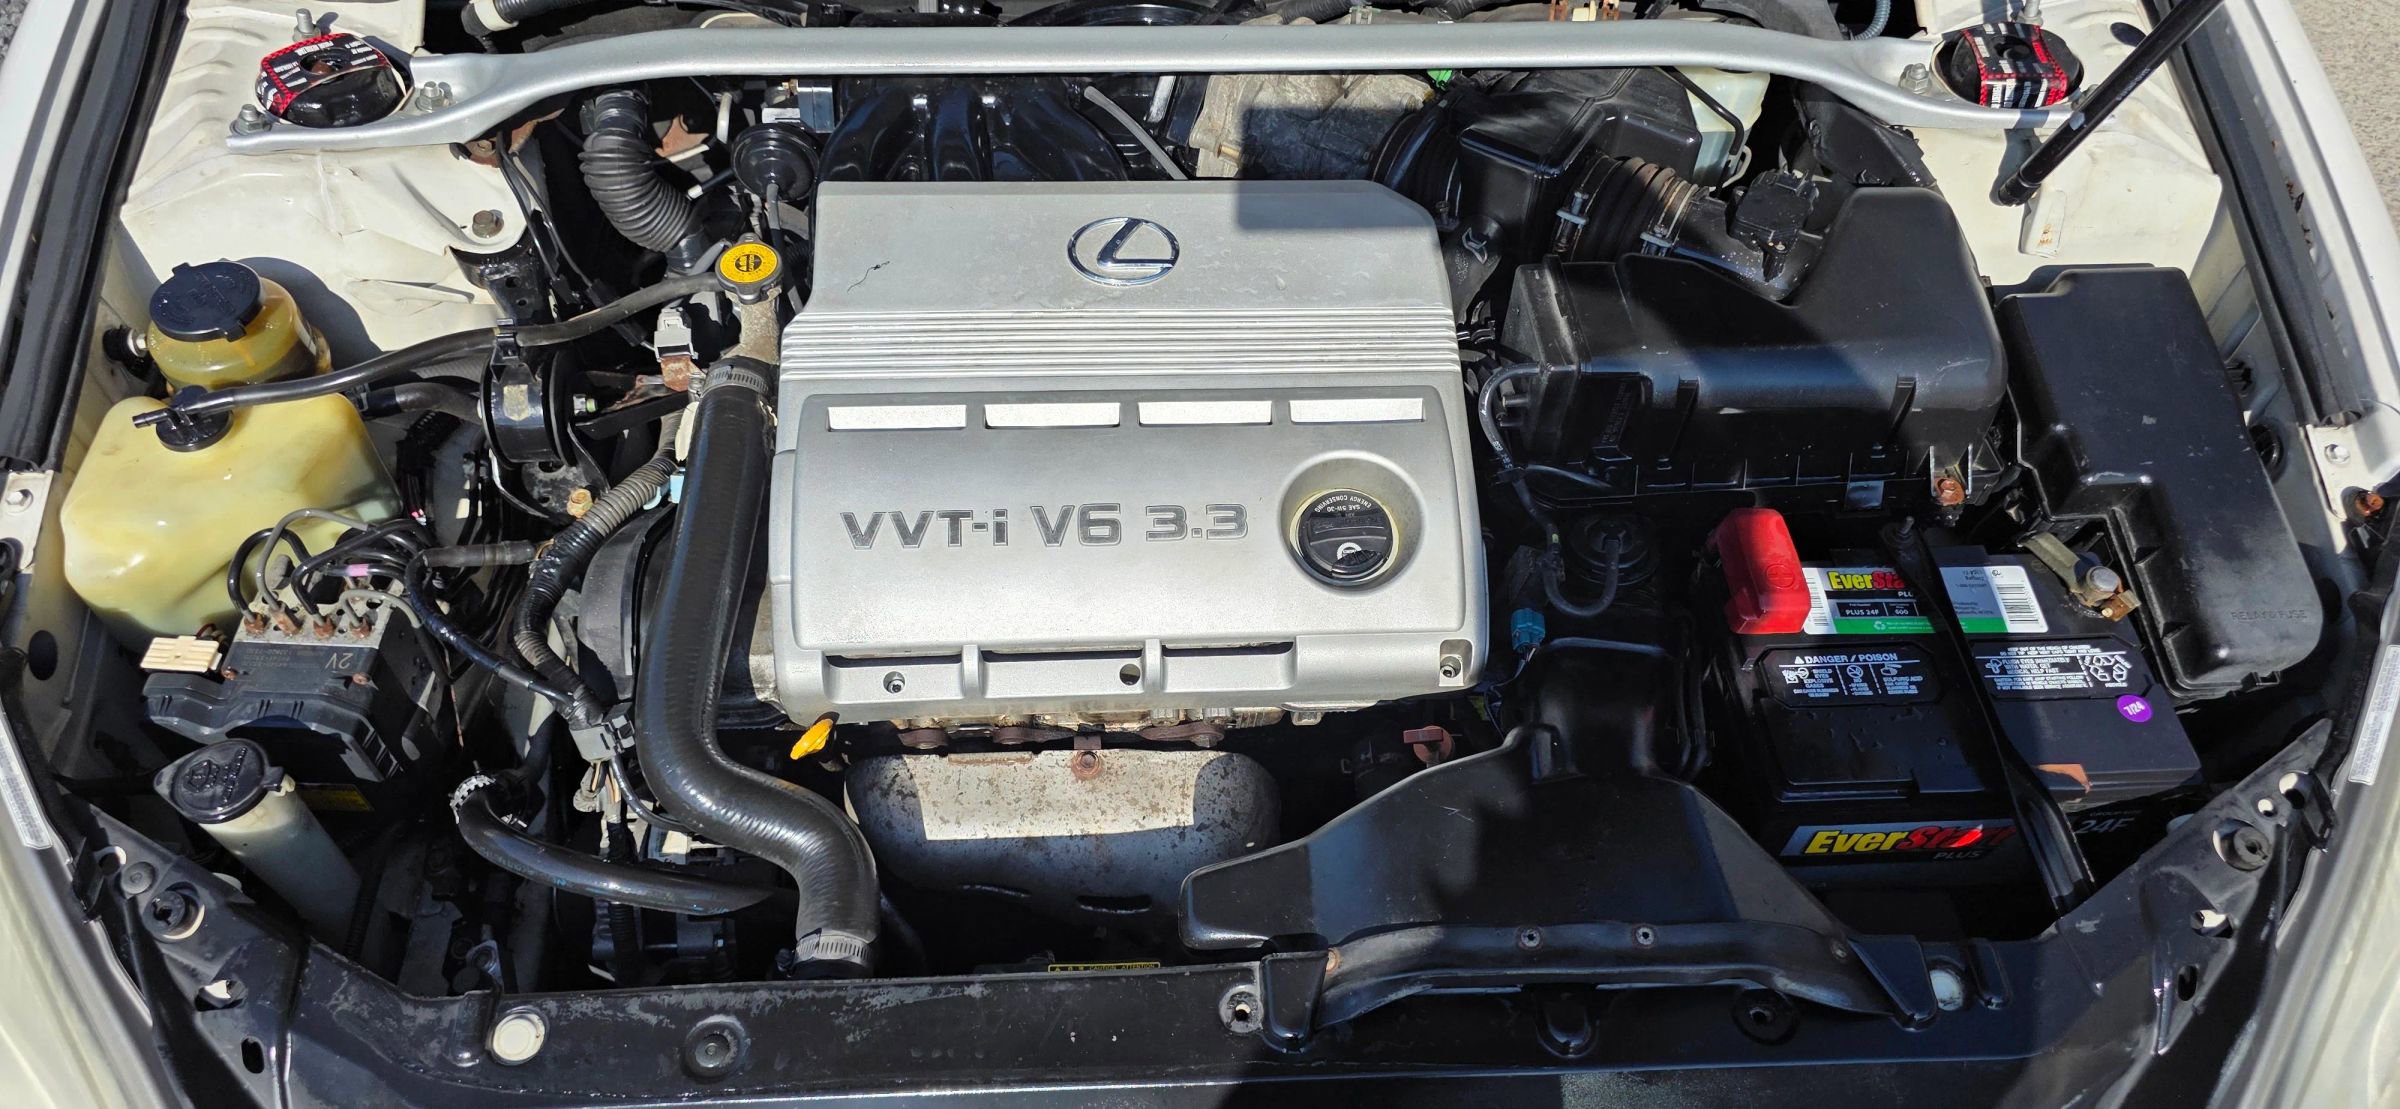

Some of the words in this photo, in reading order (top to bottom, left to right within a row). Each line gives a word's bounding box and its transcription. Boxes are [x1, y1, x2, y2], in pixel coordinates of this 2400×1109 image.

[1314, 495, 1348, 513] CONSERVING
[1350, 496, 1372, 509] ENERGY
[840, 508, 1009, 550] VVT-i
[1029, 502, 1122, 549] V6
[1145, 503, 1249, 543] 3.3
[1804, 655, 1848, 664] DANGER
[1858, 653, 1897, 662] POISON
[1933, 850, 1983, 860] PLUS
